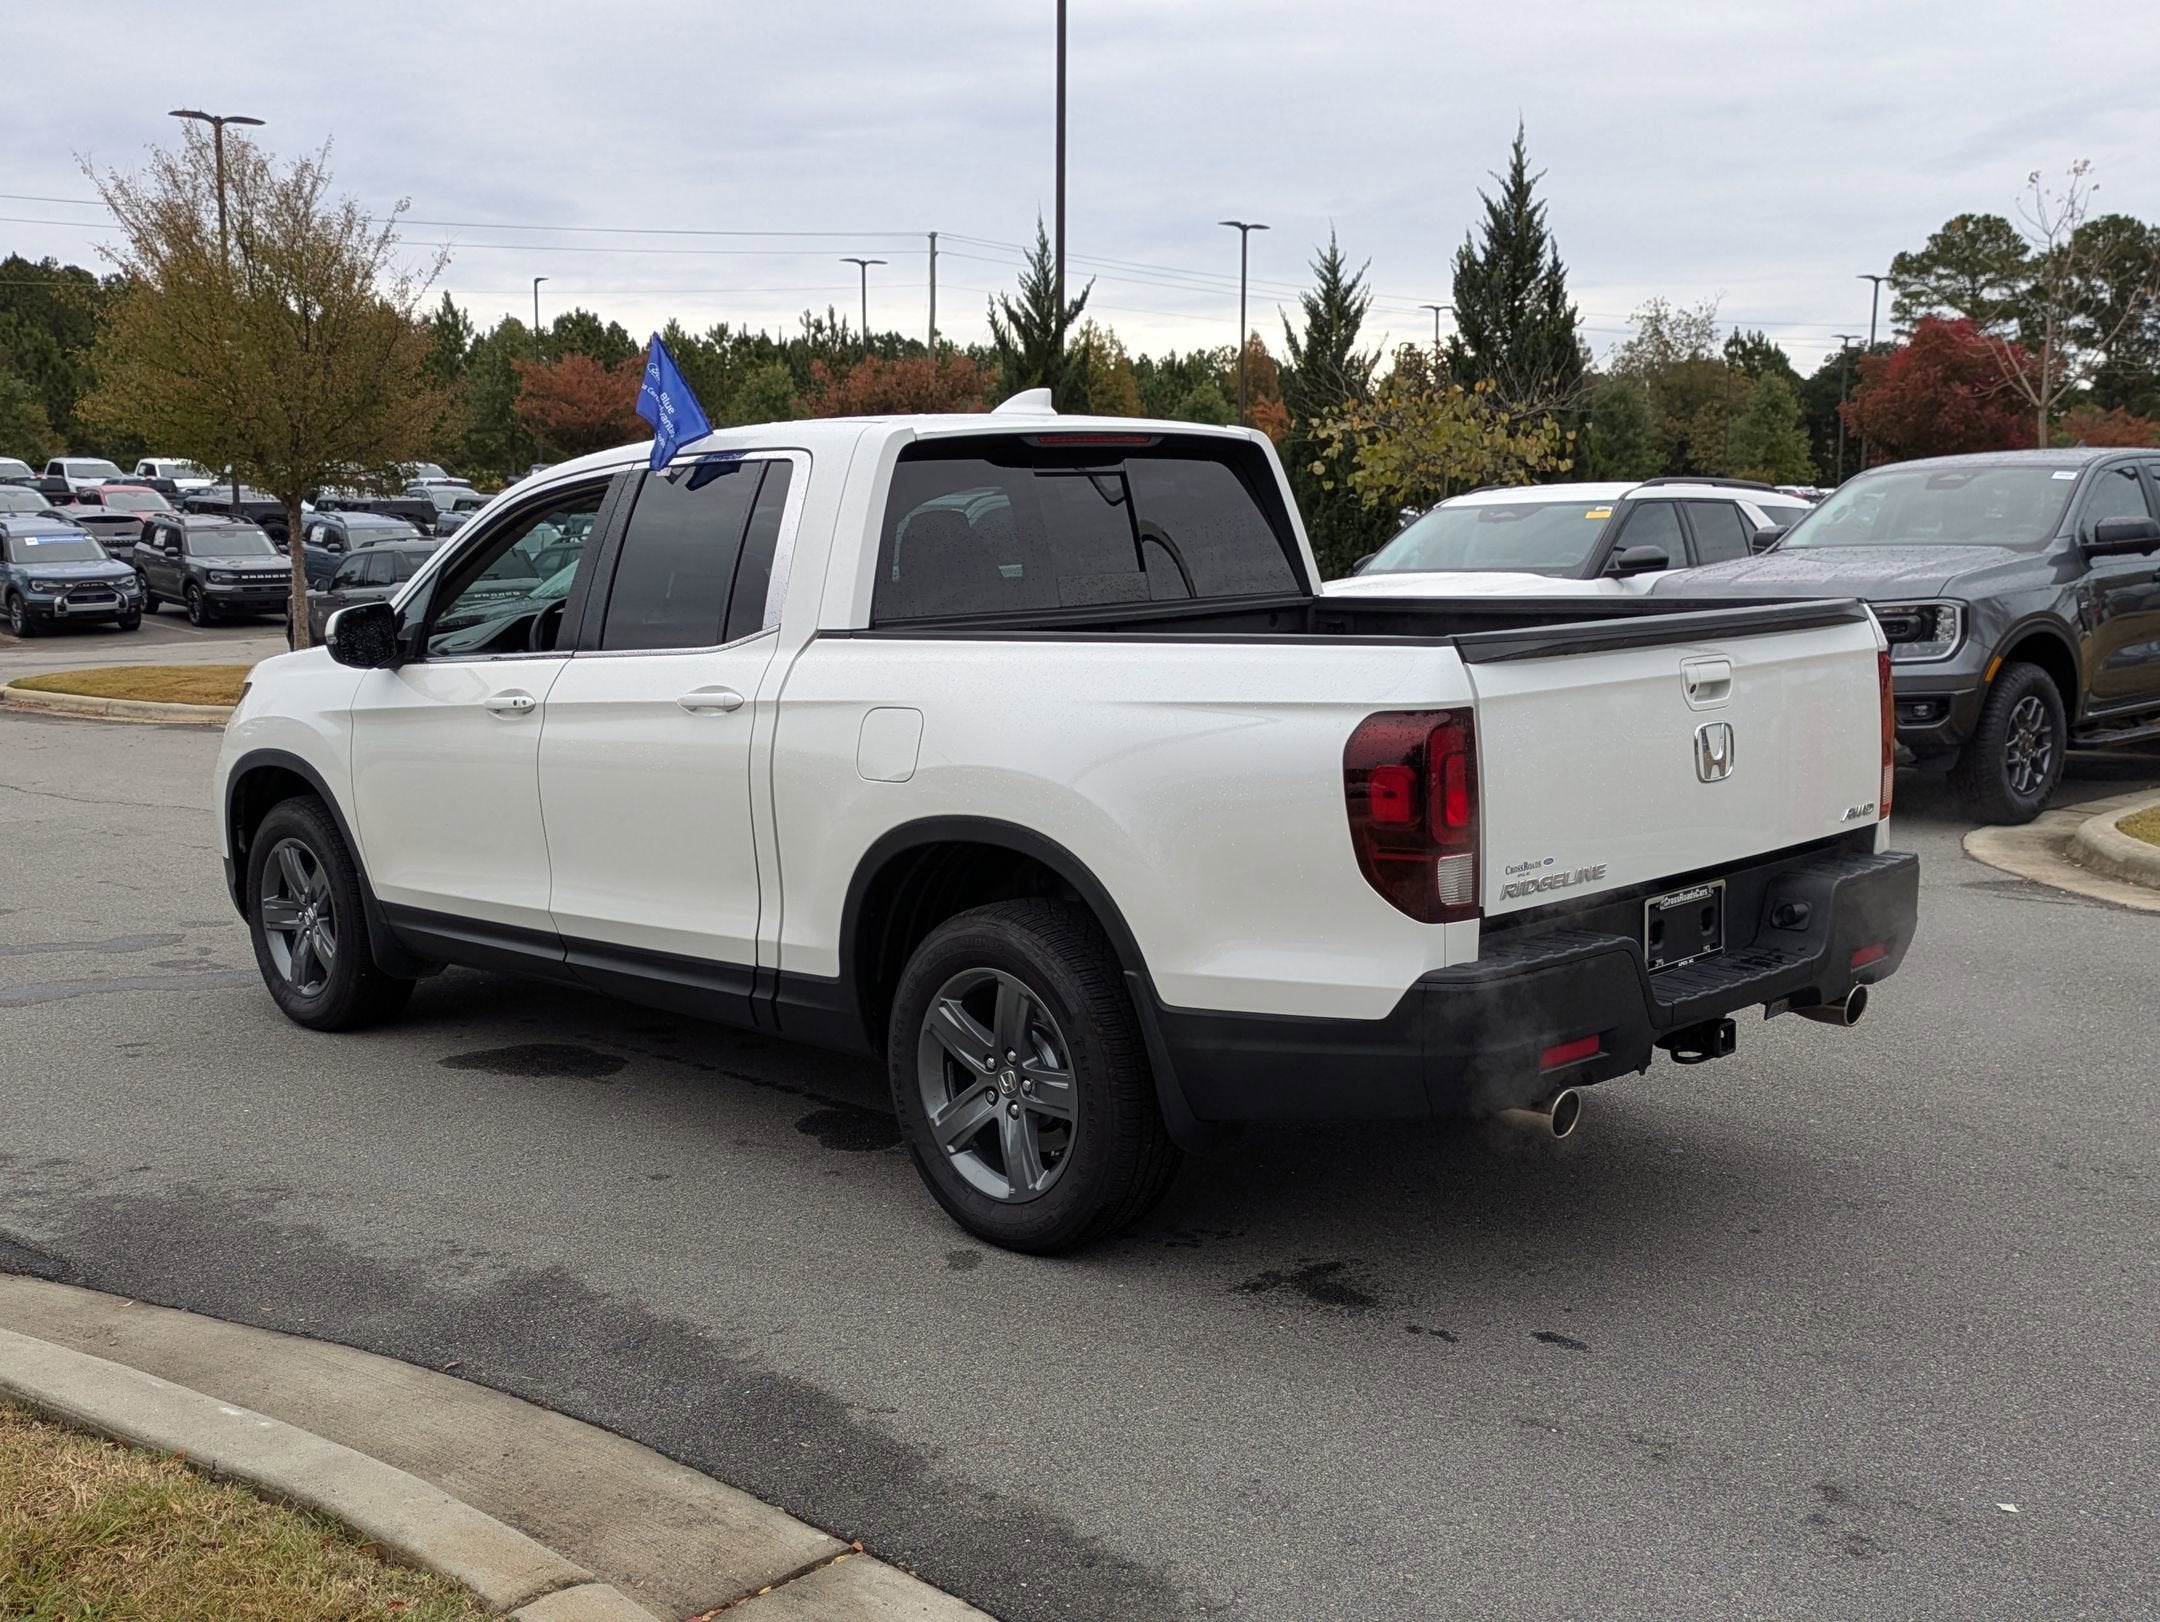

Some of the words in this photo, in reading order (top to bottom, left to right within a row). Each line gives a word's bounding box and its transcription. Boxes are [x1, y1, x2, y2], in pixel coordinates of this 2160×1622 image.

[660, 392, 675, 415] Blue
[1840, 802, 1874, 822] AWD
[1500, 863, 1607, 901] RIDGELINE
